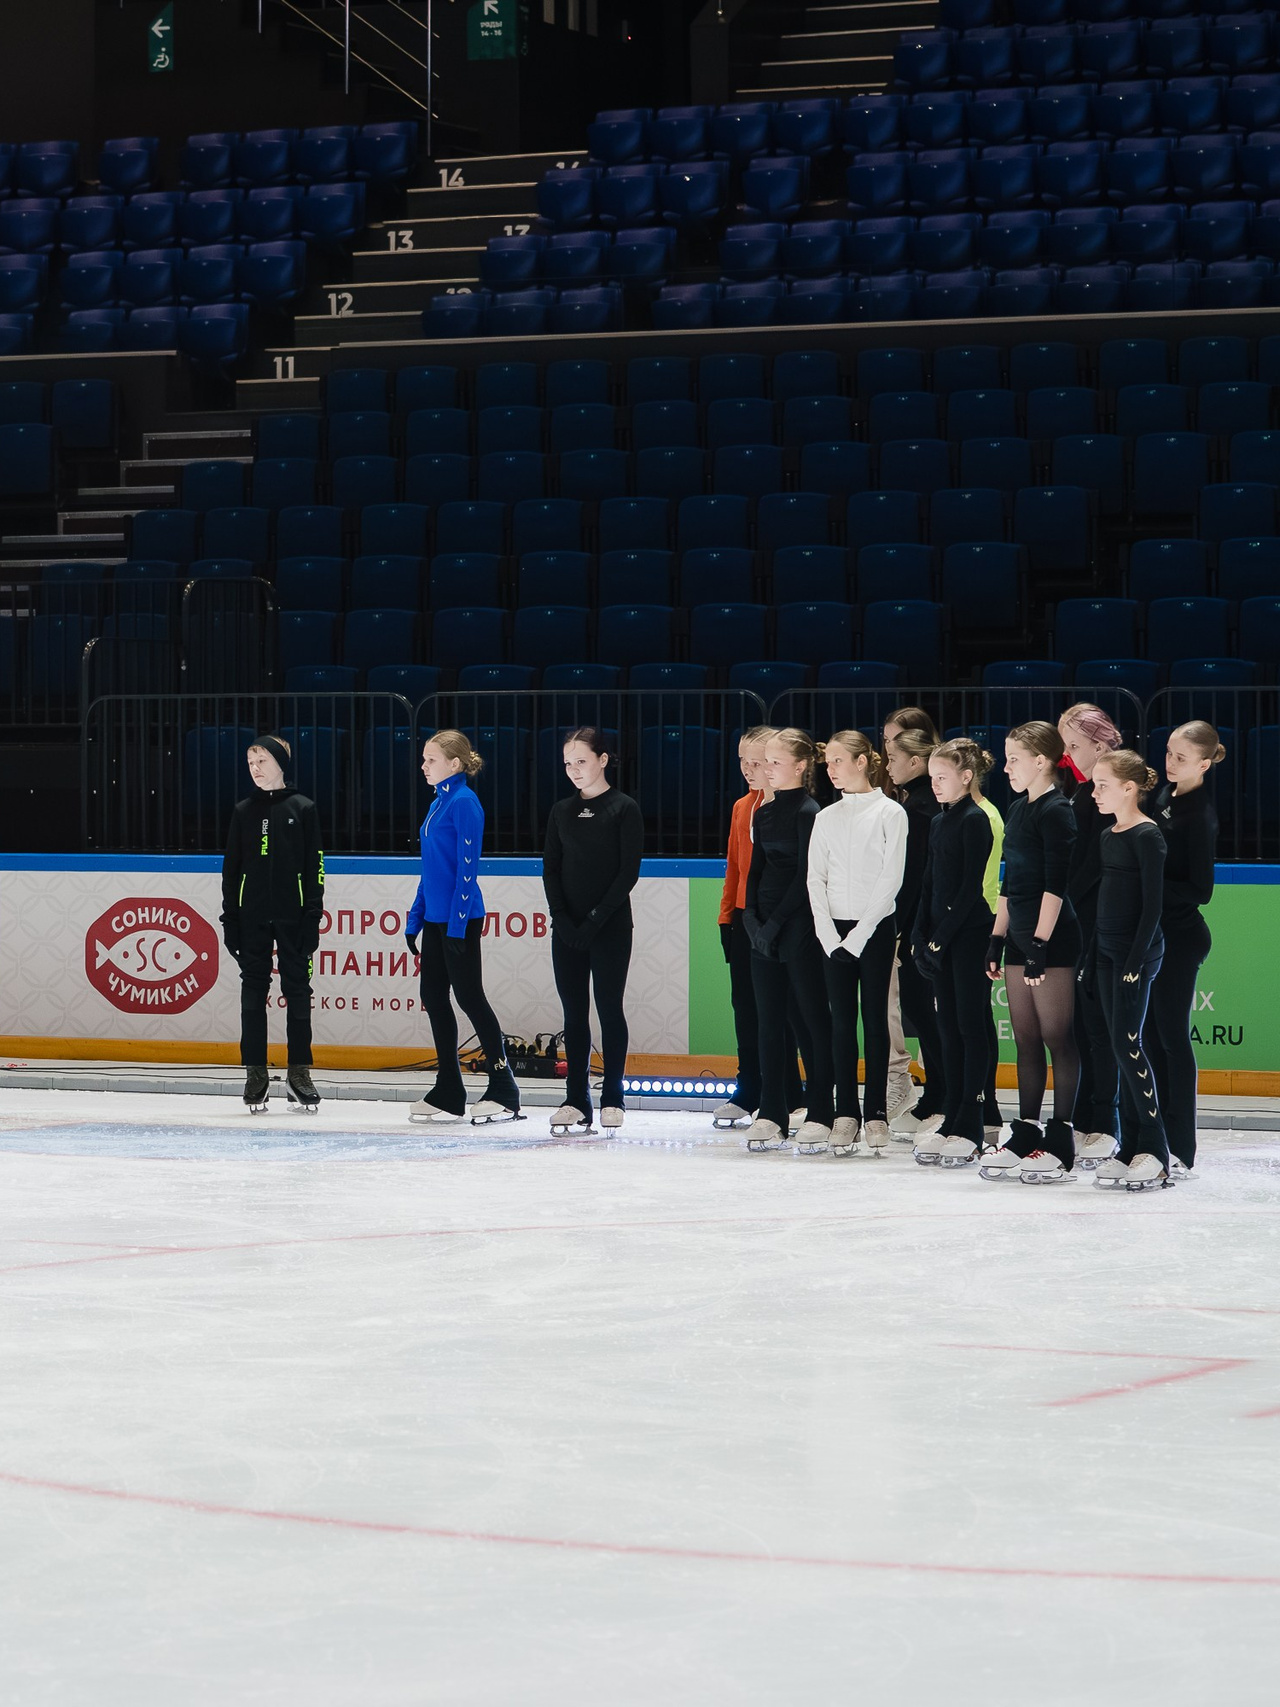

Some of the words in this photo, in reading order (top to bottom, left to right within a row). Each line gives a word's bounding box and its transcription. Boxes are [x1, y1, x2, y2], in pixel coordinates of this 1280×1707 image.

[438, 168, 464, 188] 14
[387, 230, 414, 251] 13
[328, 293, 354, 316] 12
[274, 356, 295, 380] 11
[111, 907, 191, 933] СОНИКО
[108, 972, 199, 1005] ЧУМИКАН
[1190, 1024, 1244, 1046] A.RU
